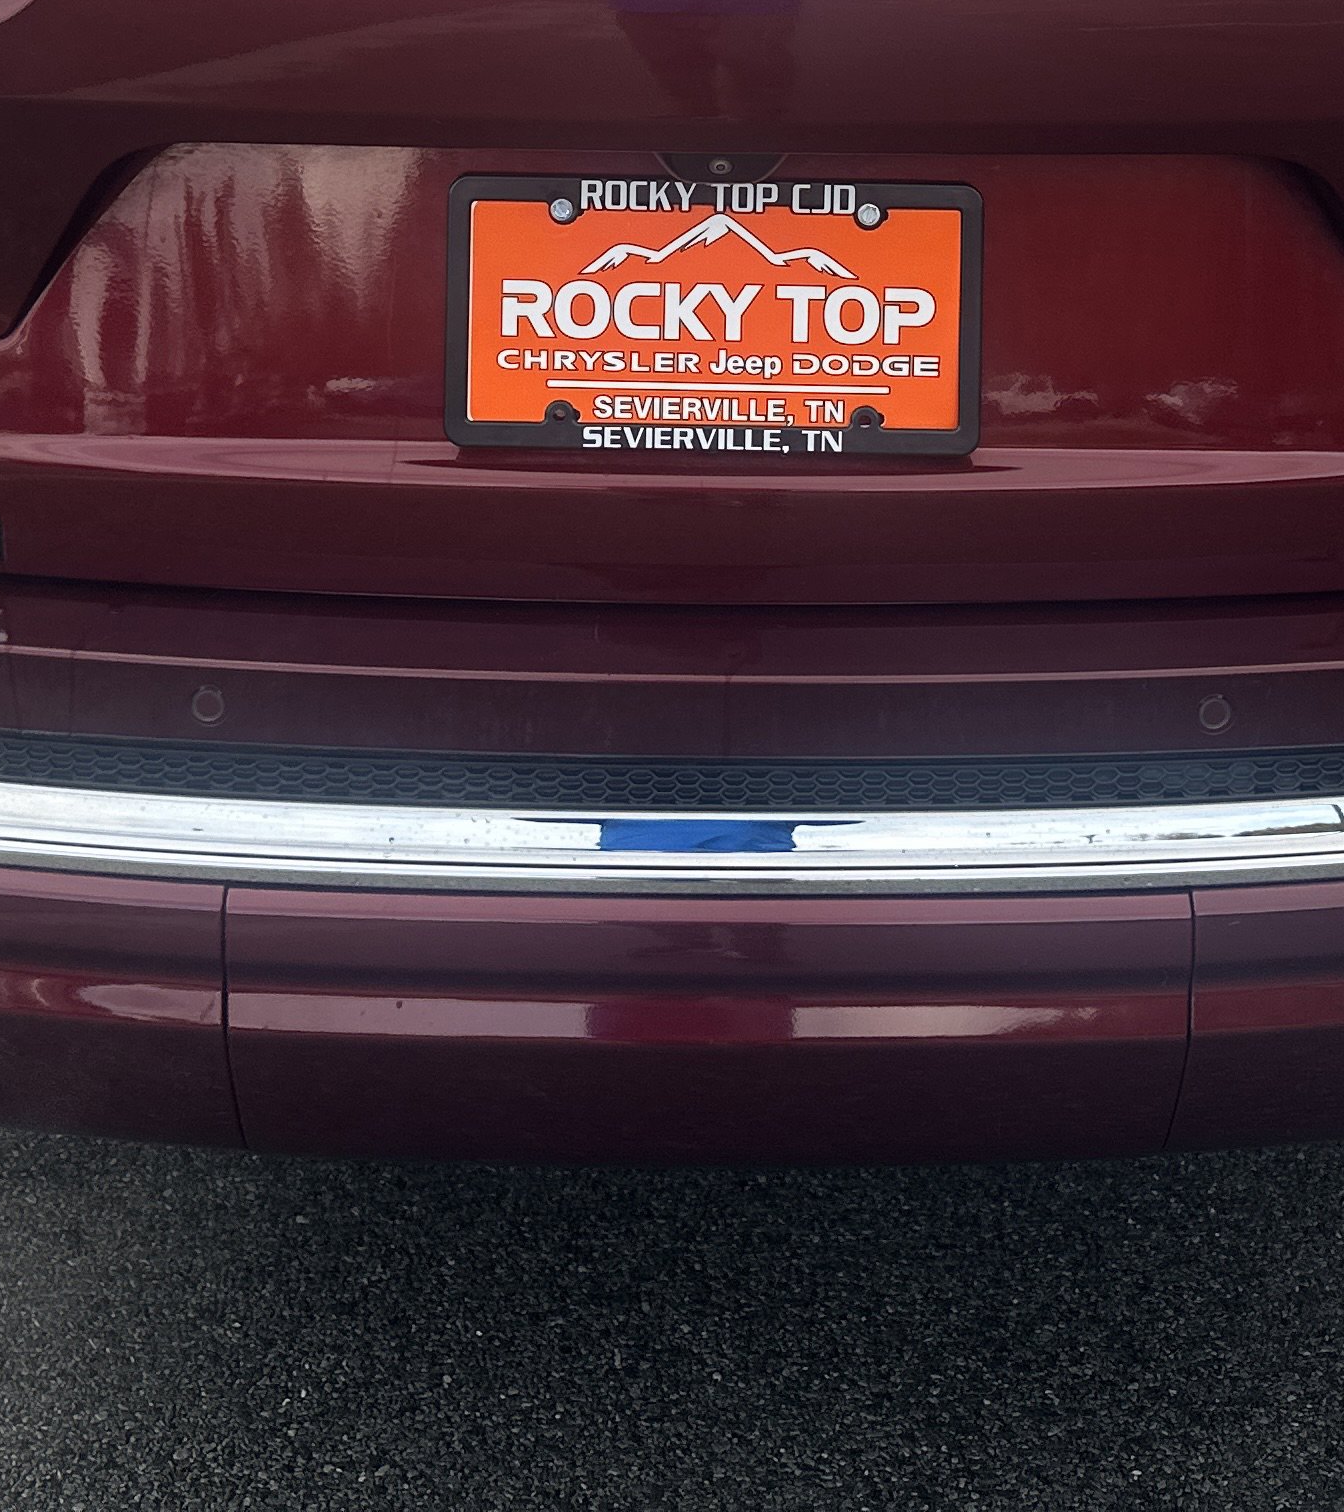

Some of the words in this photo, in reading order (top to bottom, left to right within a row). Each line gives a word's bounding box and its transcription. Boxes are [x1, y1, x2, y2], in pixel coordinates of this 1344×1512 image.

[579, 179, 697, 212] ROCKY
[711, 183, 779, 214] TOP
[792, 184, 856, 215] CJD
[499, 278, 764, 342] ROCKY
[776, 285, 937, 345] TOP
[497, 348, 702, 374] CHRYSLER
[709, 348, 782, 379] Jeep
[792, 353, 940, 378] DODGE
[593, 396, 795, 426] SEVIERVILLE,
[804, 399, 844, 424] TN
[582, 426, 790, 454] SEVIERVILLE,
[802, 429, 843, 453] TN
